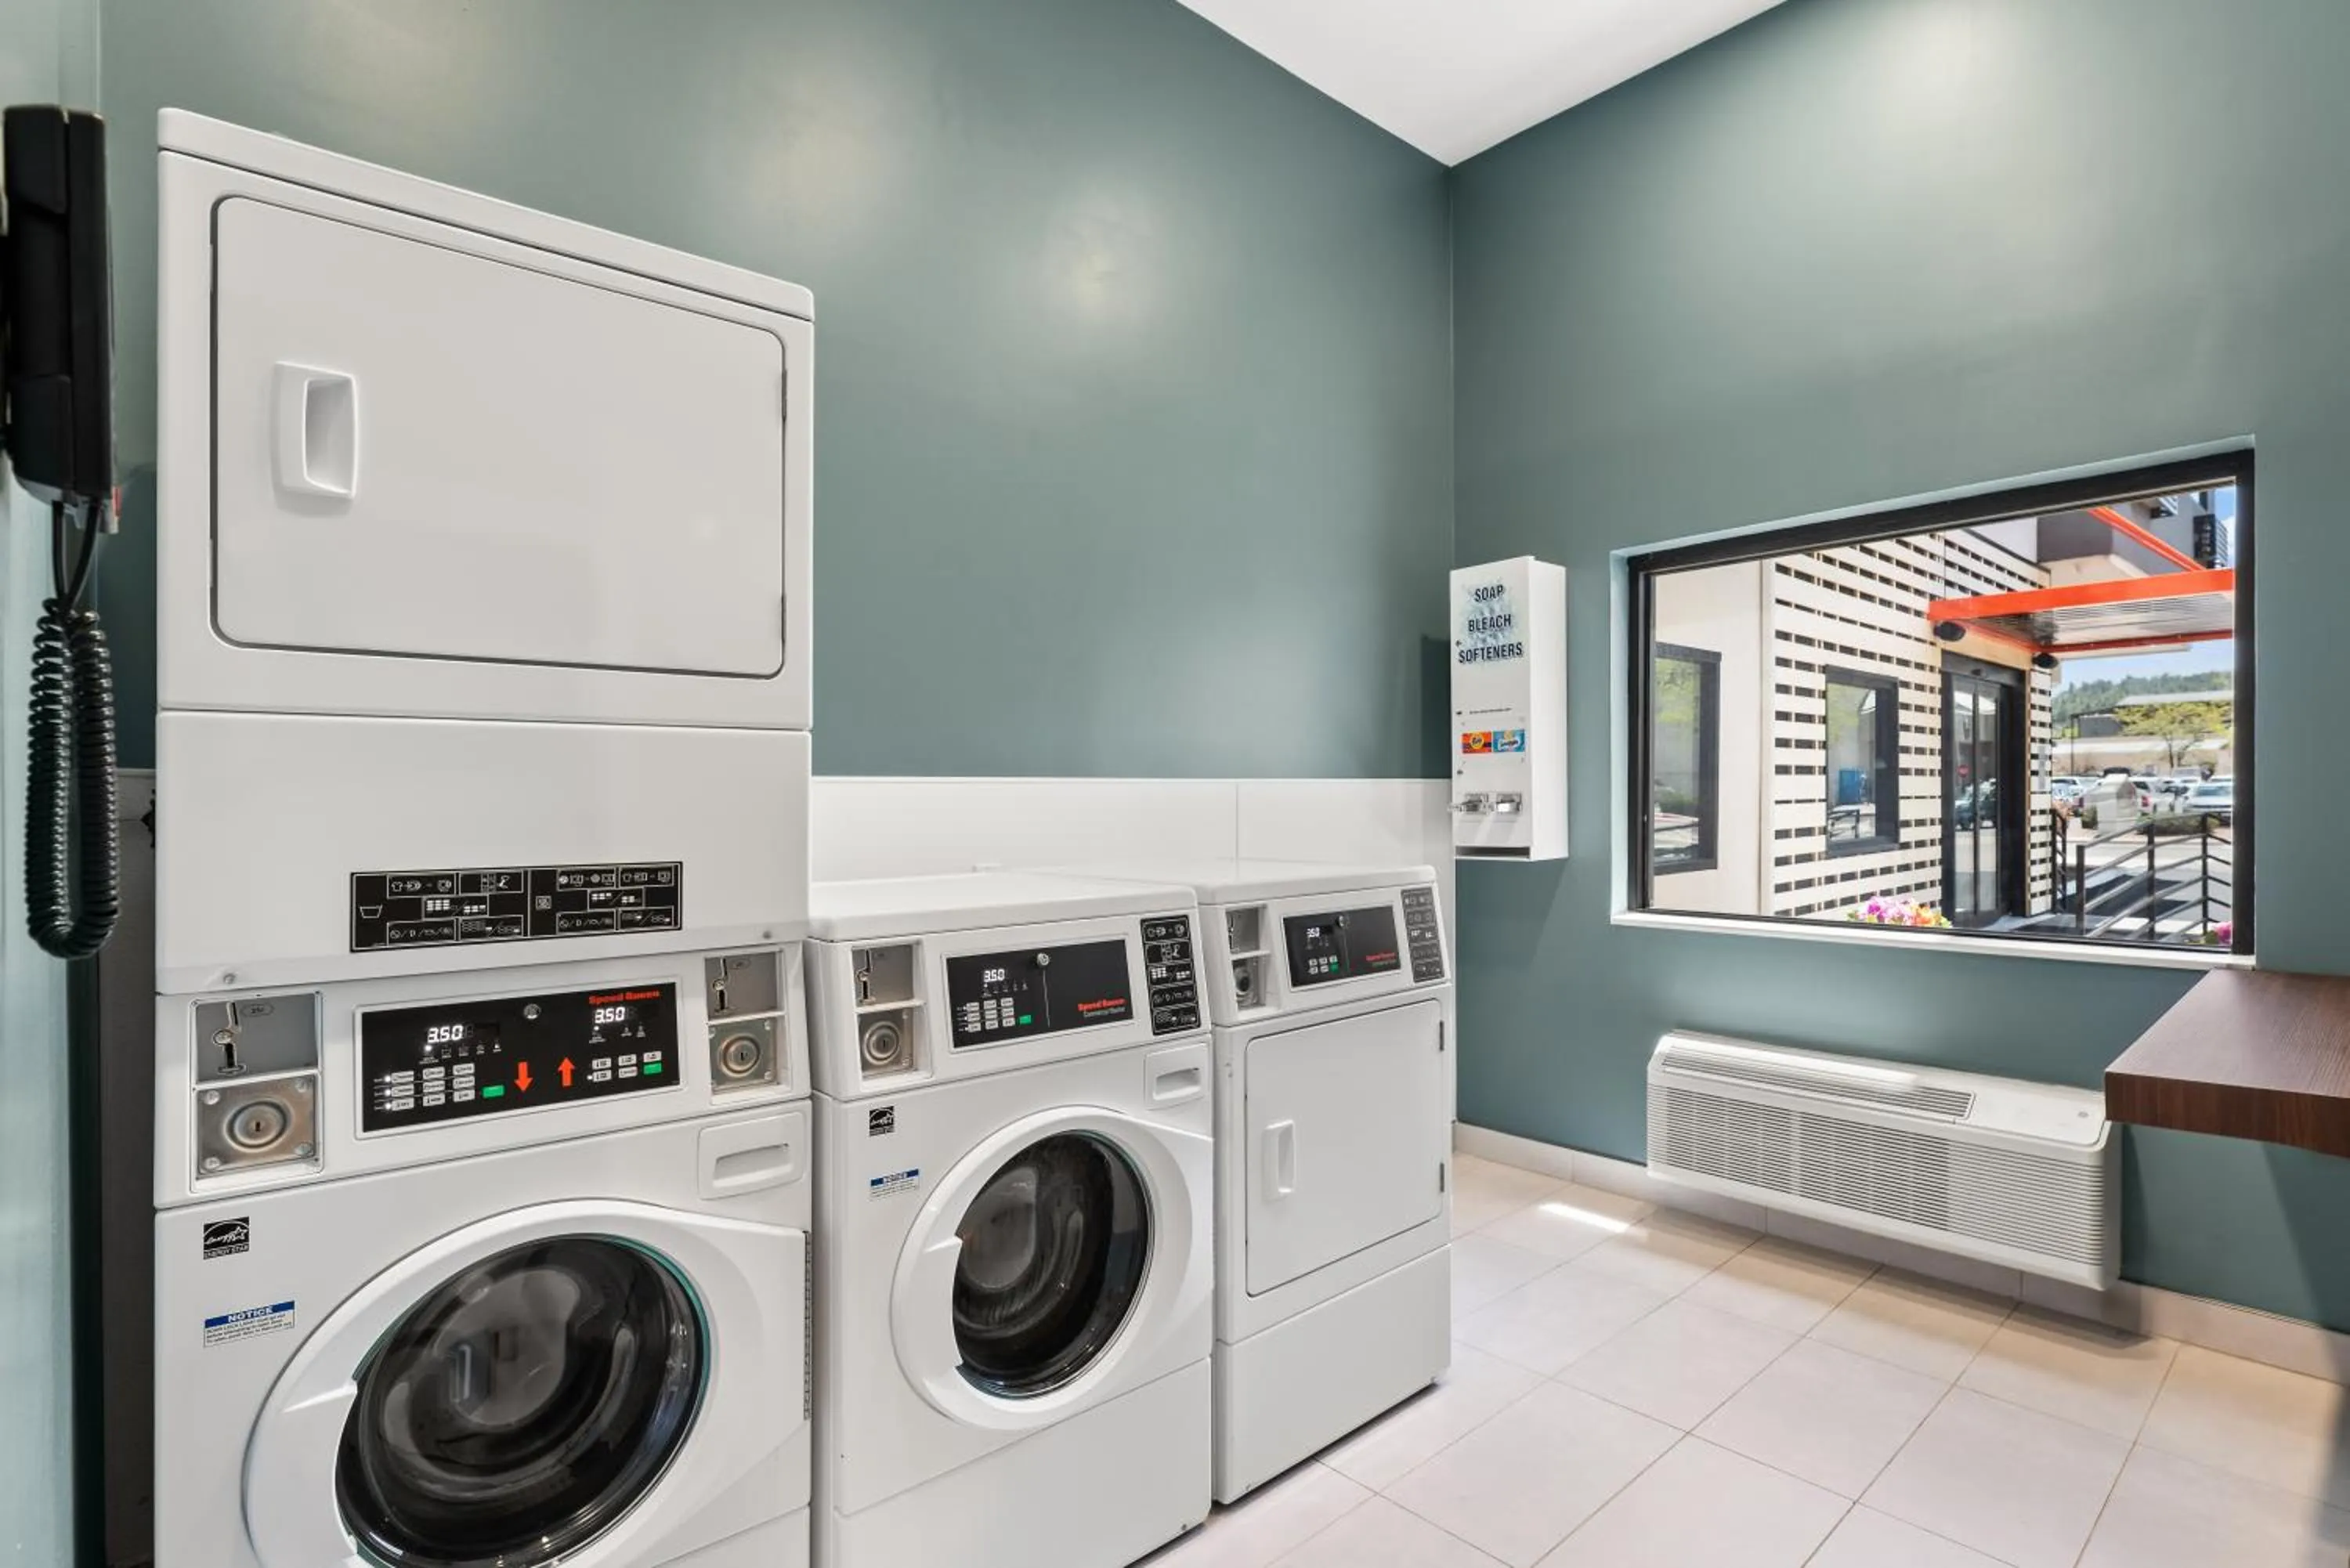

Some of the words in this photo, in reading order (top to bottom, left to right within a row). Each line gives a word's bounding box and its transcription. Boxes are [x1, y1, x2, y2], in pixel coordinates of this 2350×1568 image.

[1474, 584, 1504, 602] SOAP
[1468, 614, 1512, 632] BLEACH
[1458, 642, 1523, 663] SOFTENERS
[228, 1305, 273, 1323] NOTICE
